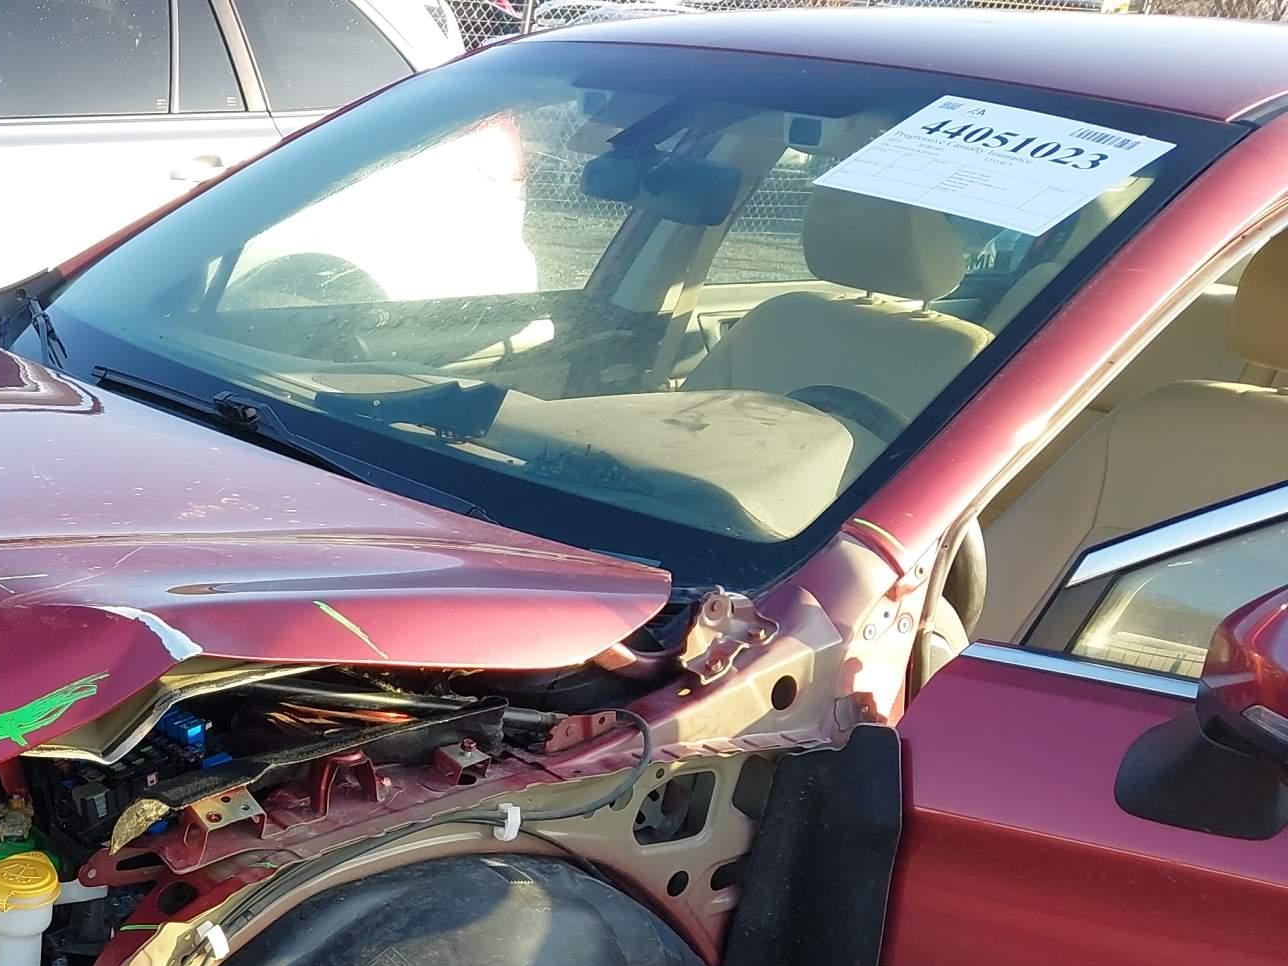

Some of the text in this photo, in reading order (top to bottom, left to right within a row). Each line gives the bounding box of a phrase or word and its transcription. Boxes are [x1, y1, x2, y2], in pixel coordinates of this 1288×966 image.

[895, 129, 947, 147] Progressive
[948, 141, 984, 155] Casualty
[987, 149, 1034, 165] Insurance
[920, 119, 1110, 170] 44051023
